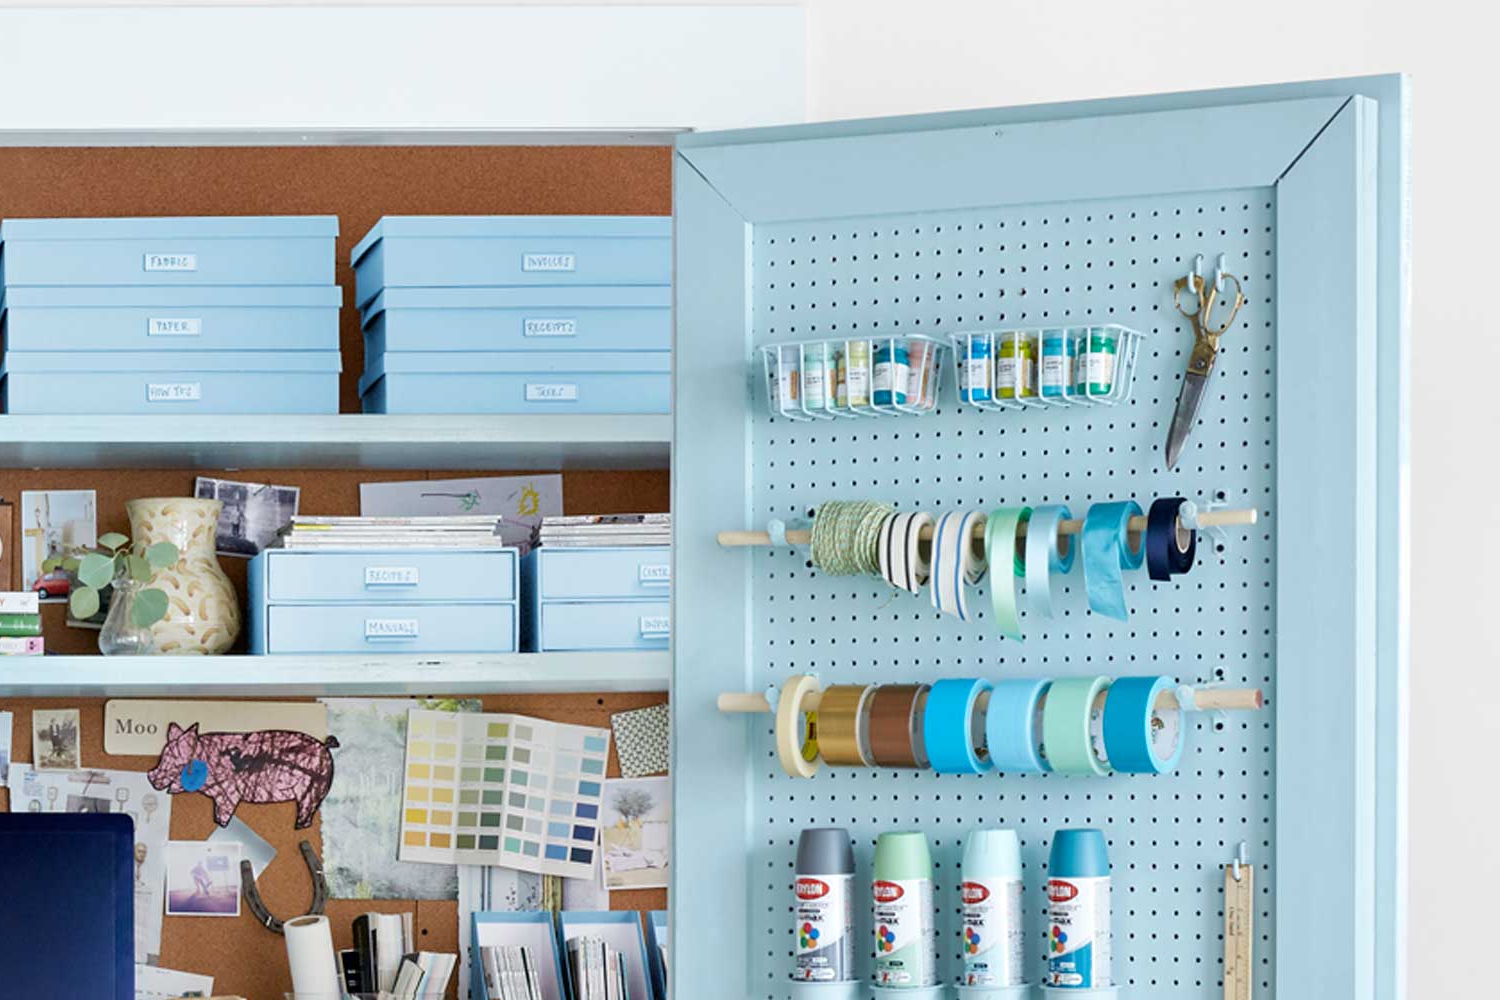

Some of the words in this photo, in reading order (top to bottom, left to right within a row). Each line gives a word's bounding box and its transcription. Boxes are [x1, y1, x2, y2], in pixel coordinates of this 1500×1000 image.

[150, 255, 189, 268] FABRIC
[155, 320, 190, 332] PAPER
[527, 321, 574, 333] RECEIPTS
[115, 718, 158, 735] Moo
